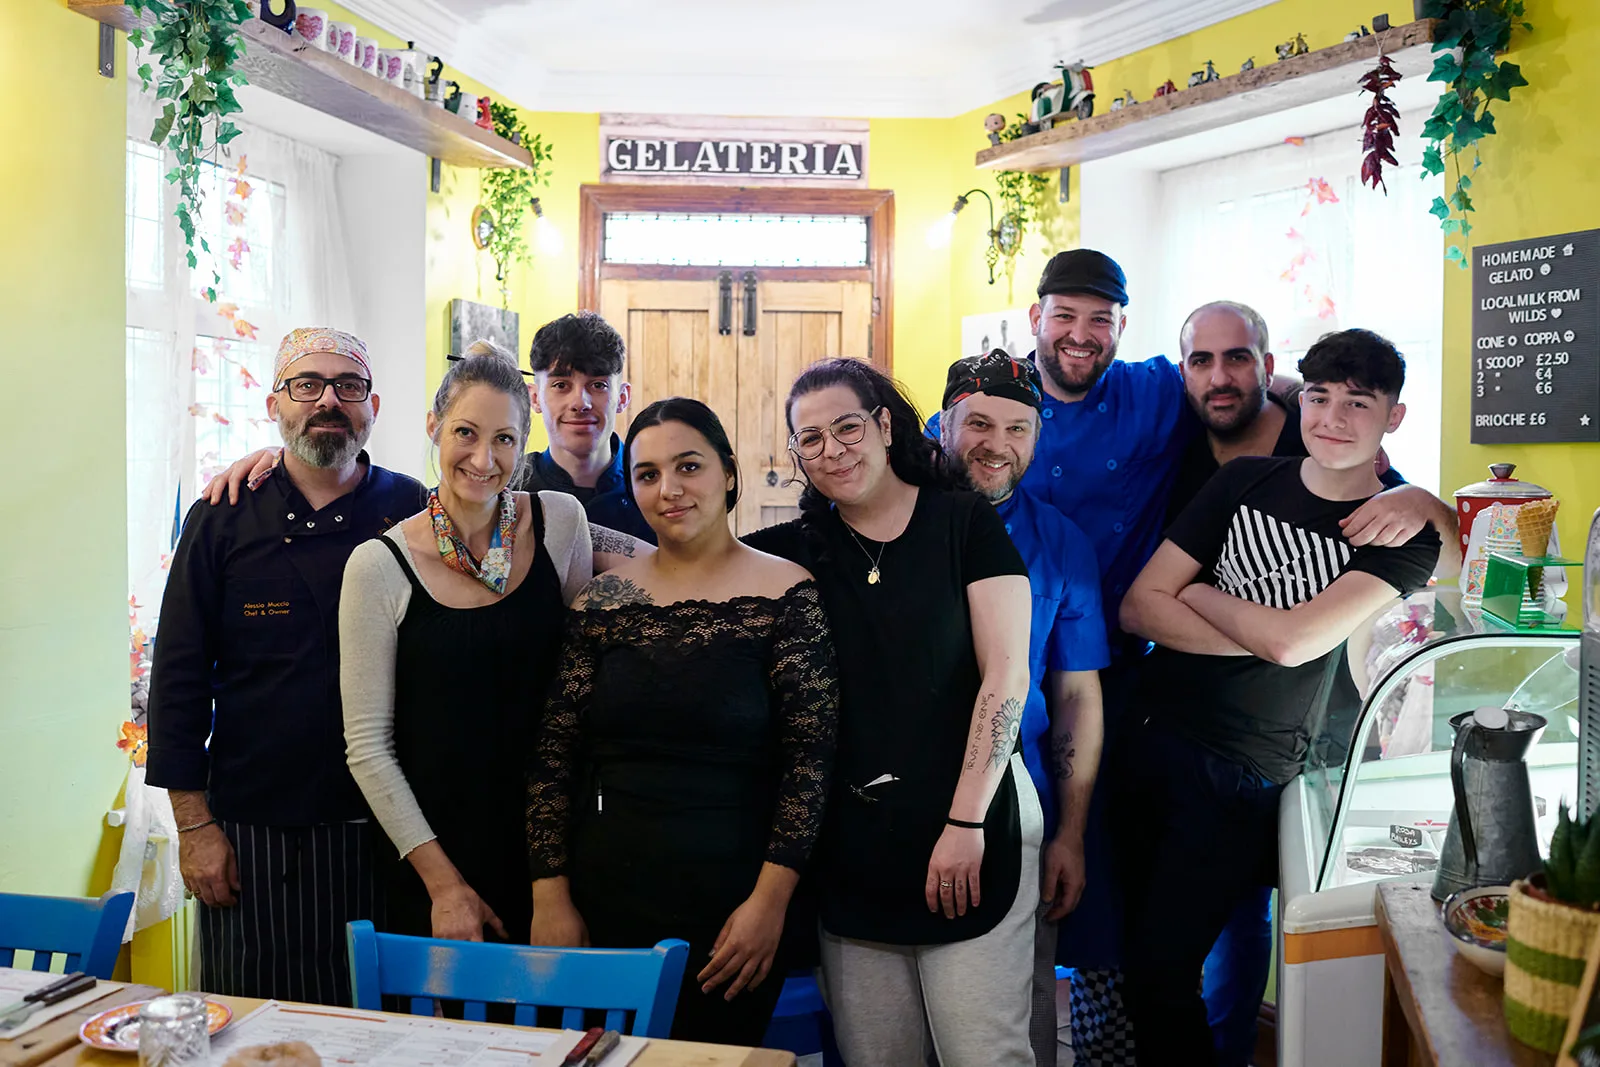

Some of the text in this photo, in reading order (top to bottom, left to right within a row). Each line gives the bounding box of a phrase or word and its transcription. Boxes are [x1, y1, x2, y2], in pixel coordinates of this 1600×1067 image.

[608, 139, 861, 175] GELATERIA
[1482, 246, 1556, 268] HOMEMADE
[1489, 268, 1533, 284] GELATO
[1481, 288, 1580, 311] LOCAL MILK FROM
[1508, 308, 1547, 324] WILDS
[1477, 336, 1504, 349] CONE
[1524, 331, 1561, 346] COPPA
[1477, 352, 1569, 370] 1 SCOOP £2.50
[1477, 371, 1484, 384] 2
[1477, 385, 1484, 397] 3
[1475, 413, 1546, 427] BRIOCHE £6
